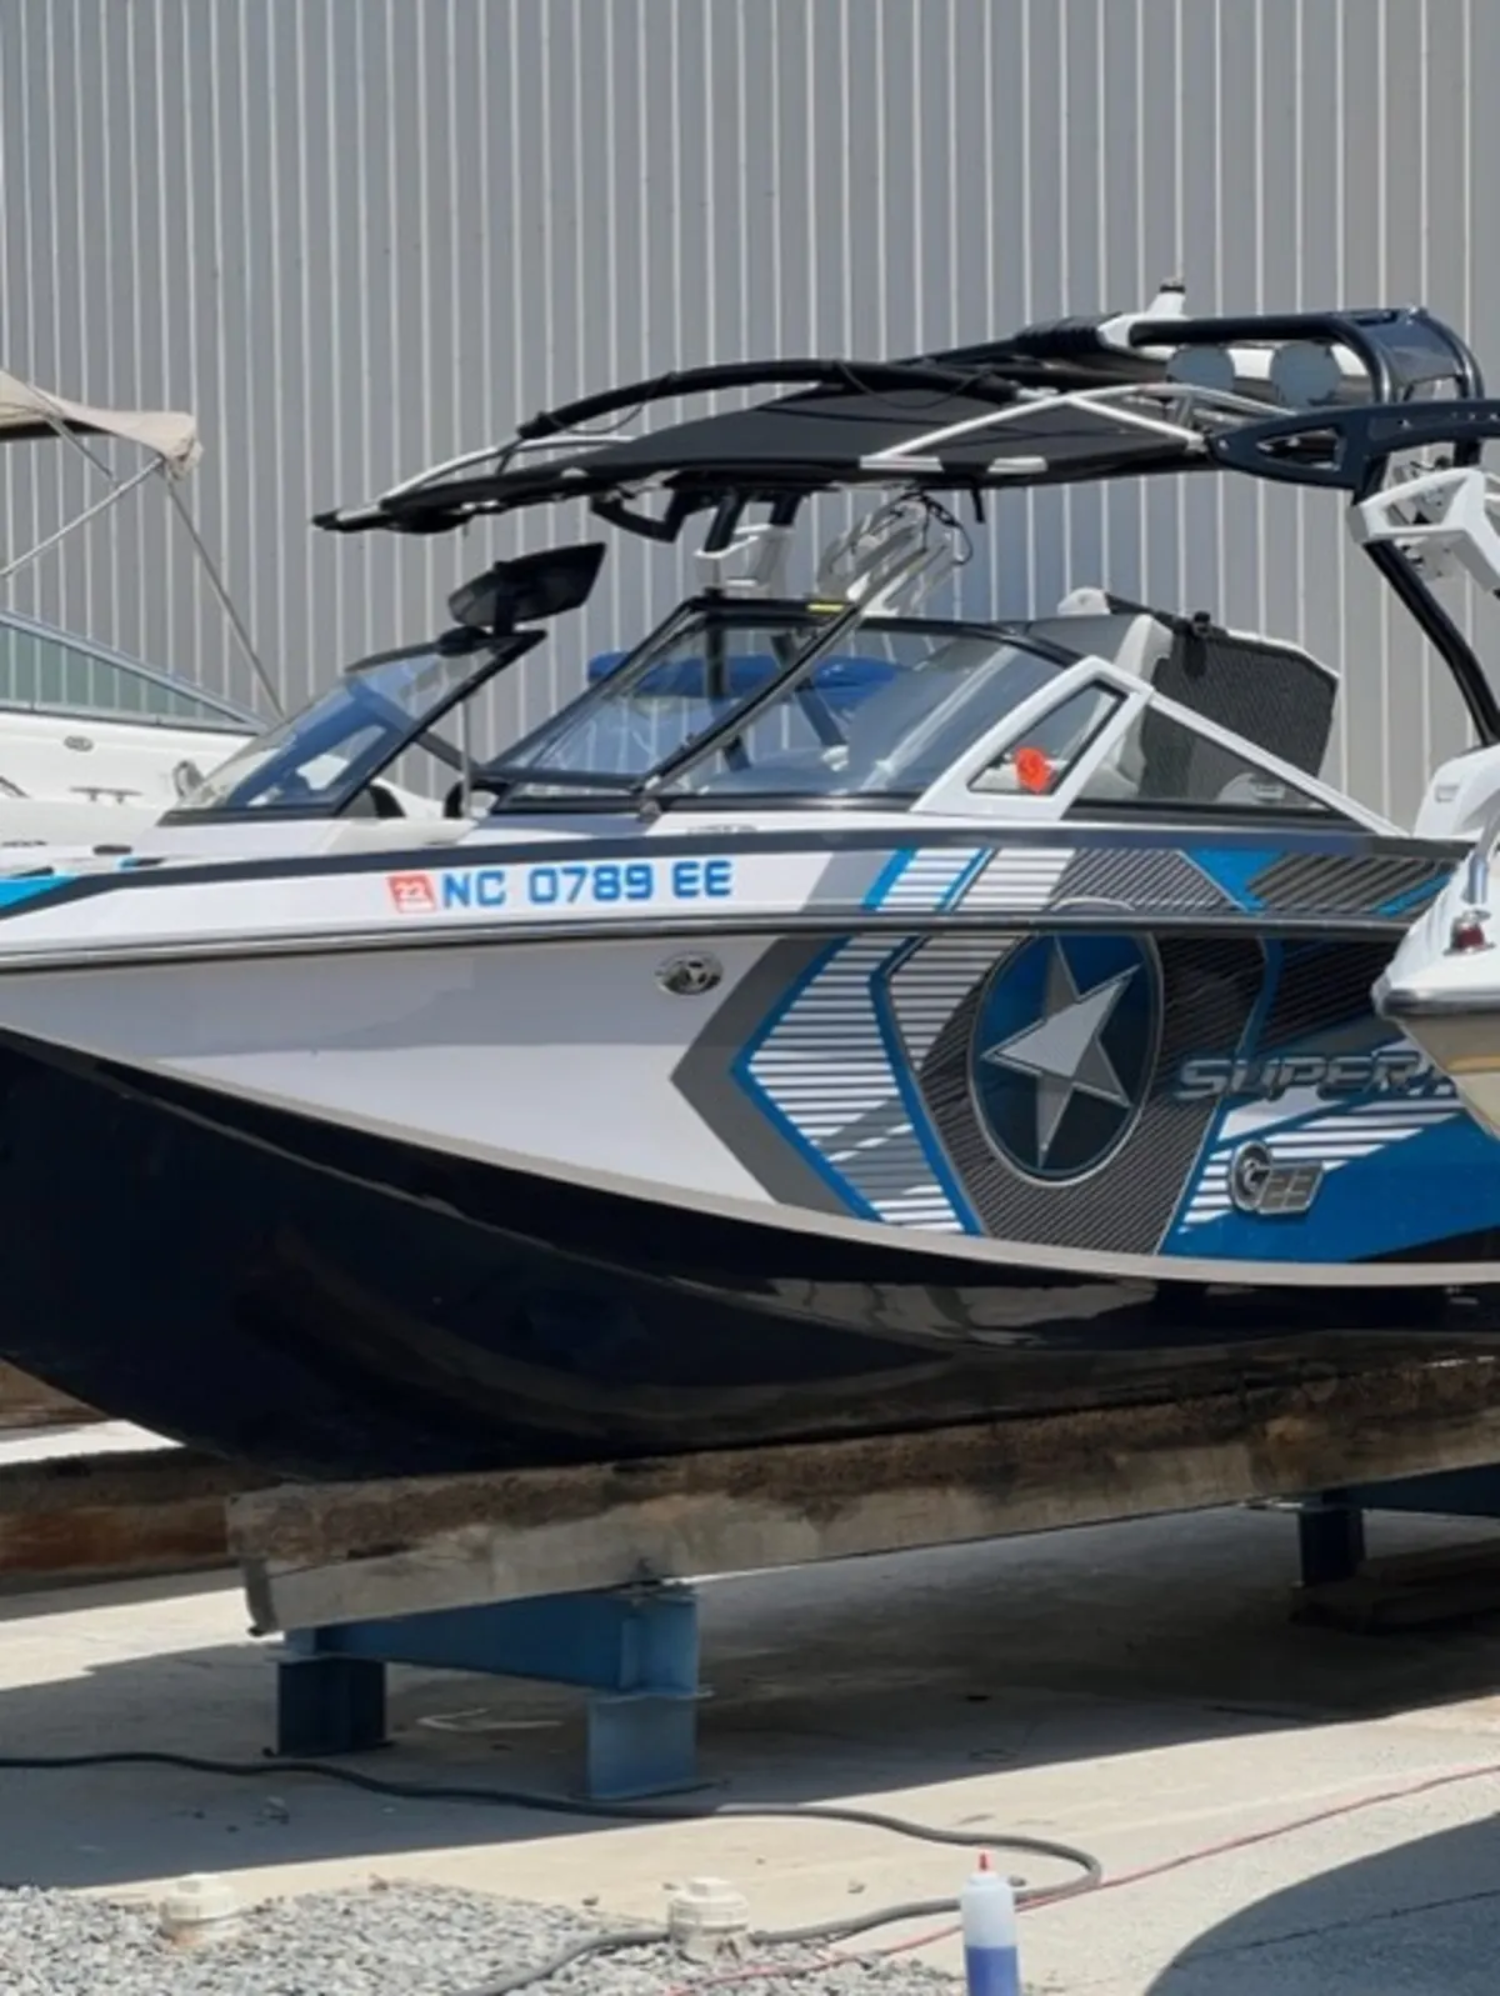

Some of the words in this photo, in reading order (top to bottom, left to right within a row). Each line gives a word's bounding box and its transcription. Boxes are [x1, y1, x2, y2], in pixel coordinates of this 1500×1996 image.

[441, 870, 505, 909] NC
[528, 864, 653, 904] 0789
[672, 860, 733, 898] EE
[1174, 1053, 1420, 1099] SUPER
